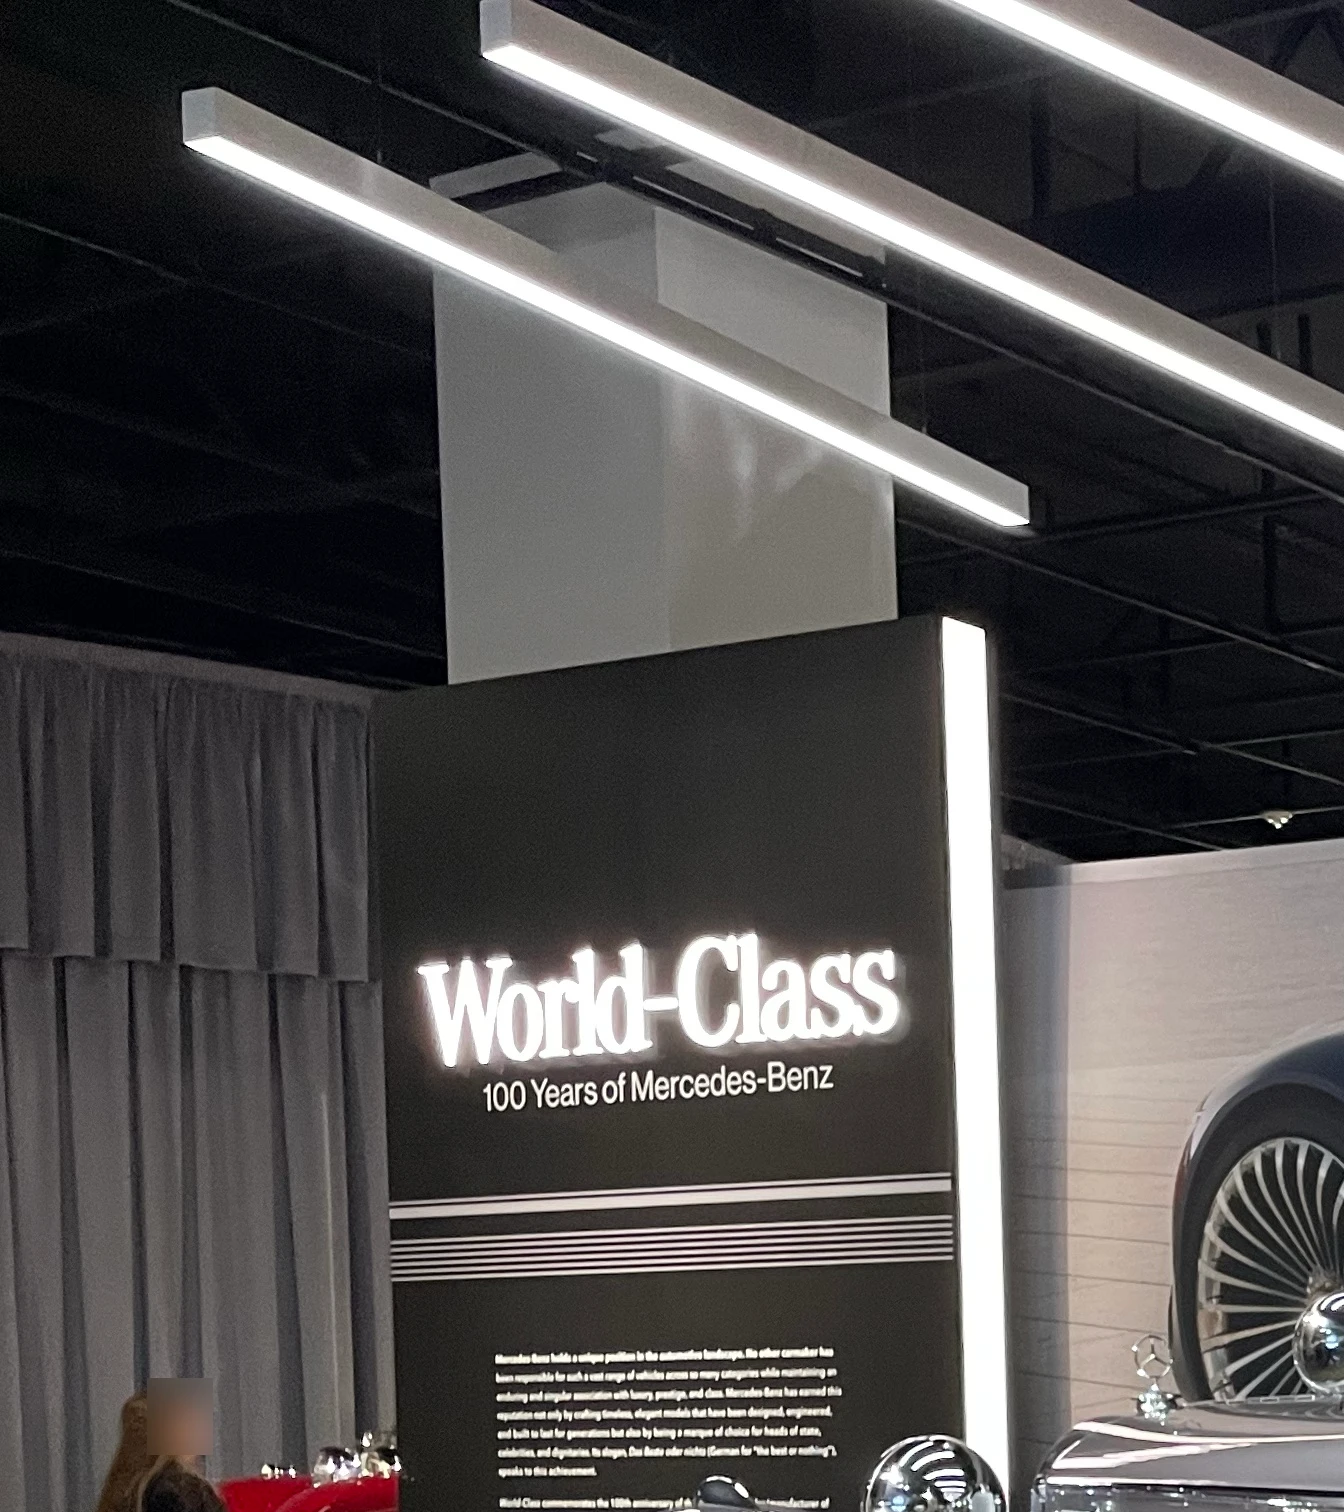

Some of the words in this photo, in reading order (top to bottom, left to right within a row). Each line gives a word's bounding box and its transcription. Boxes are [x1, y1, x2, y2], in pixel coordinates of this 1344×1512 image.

[417, 928, 901, 1068] World-Class
[482, 1083, 527, 1113] 100
[531, 1077, 599, 1109] Years
[602, 1071, 627, 1104] of
[631, 1062, 834, 1103] Mercedes-Benz
